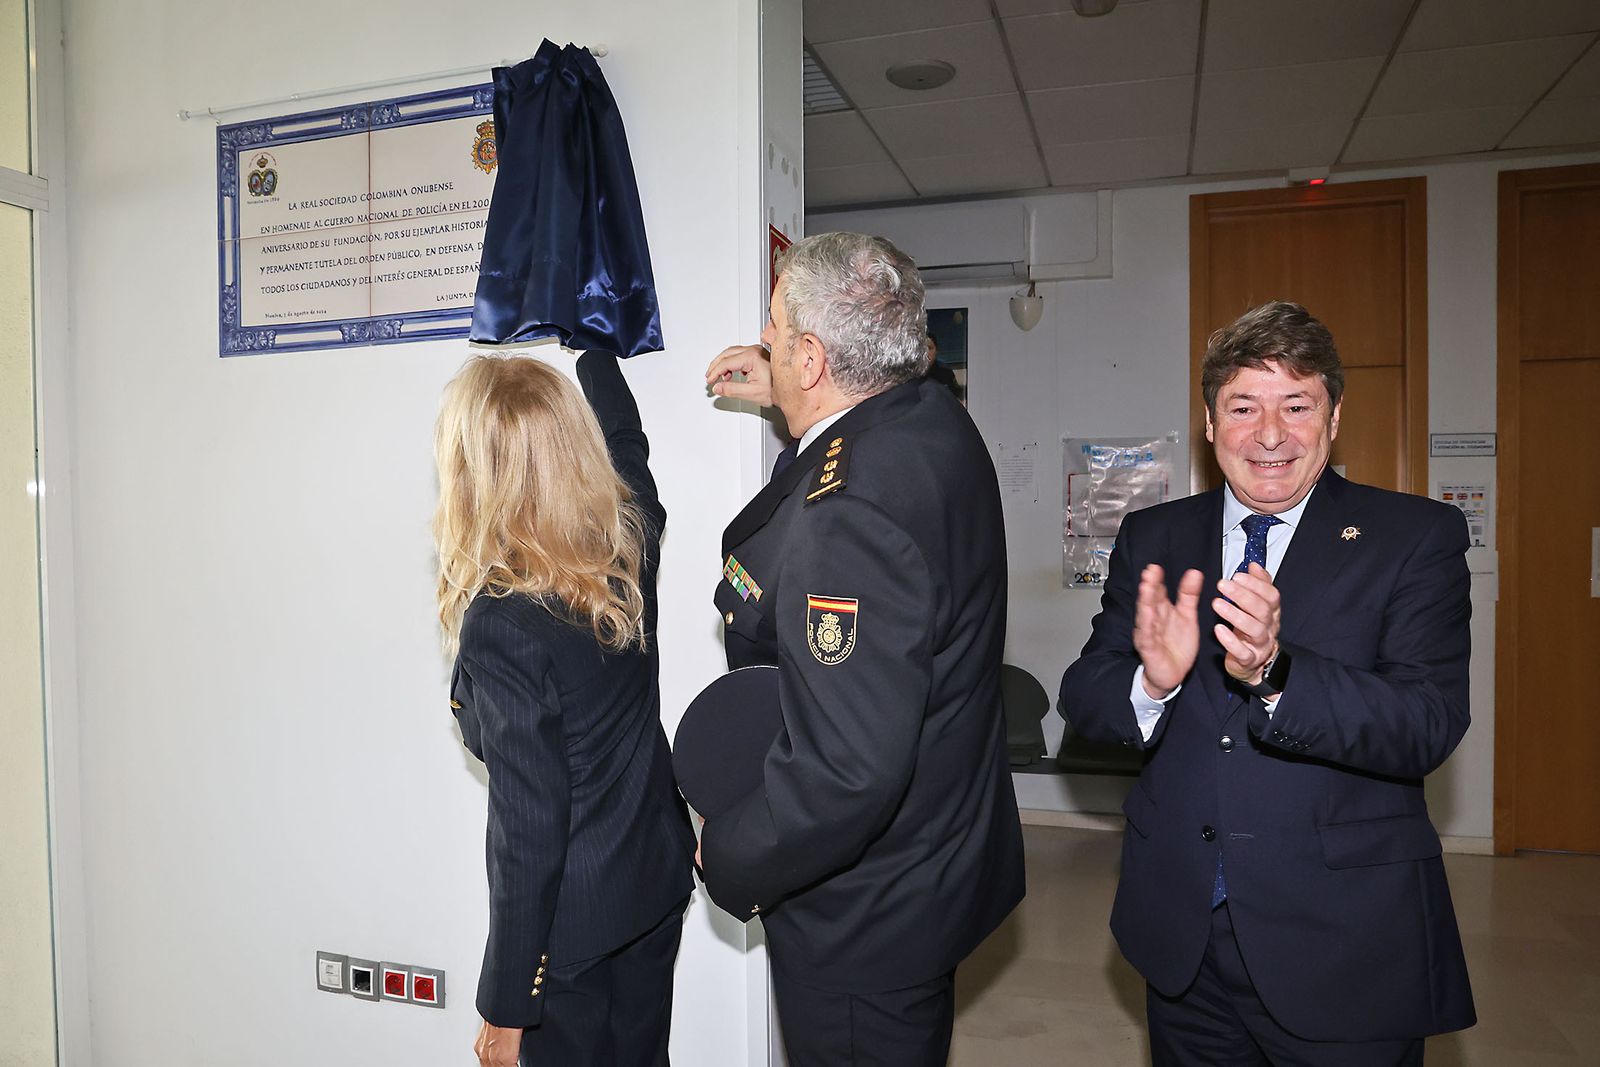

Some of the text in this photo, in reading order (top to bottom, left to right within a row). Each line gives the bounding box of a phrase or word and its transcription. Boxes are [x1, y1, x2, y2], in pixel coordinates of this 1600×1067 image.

[288, 181, 454, 211] LA REAL SOCIEDAD COLOMBINA ONUBENSE
[260, 225, 271, 235] EN
[272, 221, 311, 234] HOMENAJE
[313, 219, 323, 228] AL
[324, 215, 354, 227] CUERPO
[357, 209, 399, 223] NACIONAL
[402, 208, 413, 218] DE
[416, 201, 448, 216] POLICÍA
[449, 202, 460, 212] EN
[461, 200, 471, 210] EL
[260, 241, 309, 254] ANIVERSARIO
[309, 240, 320, 249] DE
[320, 239, 330, 248] SU
[384, 230, 400, 241] POR
[400, 229, 411, 239] SU
[412, 224, 451, 238] EJEMPLAR
[259, 266, 266, 275] Y
[266, 261, 313, 275] PERMANENTE
[314, 258, 343, 269] TUTELA
[343, 256, 358, 266] DEL
[358, 253, 386, 264] ORDEN
[425, 246, 437, 257] EN
[438, 242, 474, 255] DEFENSA
[477, 241, 485, 250] D
[260, 261, 481, 295] TODOS LOS CIUDADANOS Y DEL INTERÉS GENERAL DE ESPAÑ
[436, 294, 445, 302] LA
[445, 293, 468, 301] JUNTA
[824, 628, 854, 663] NACIONAL
